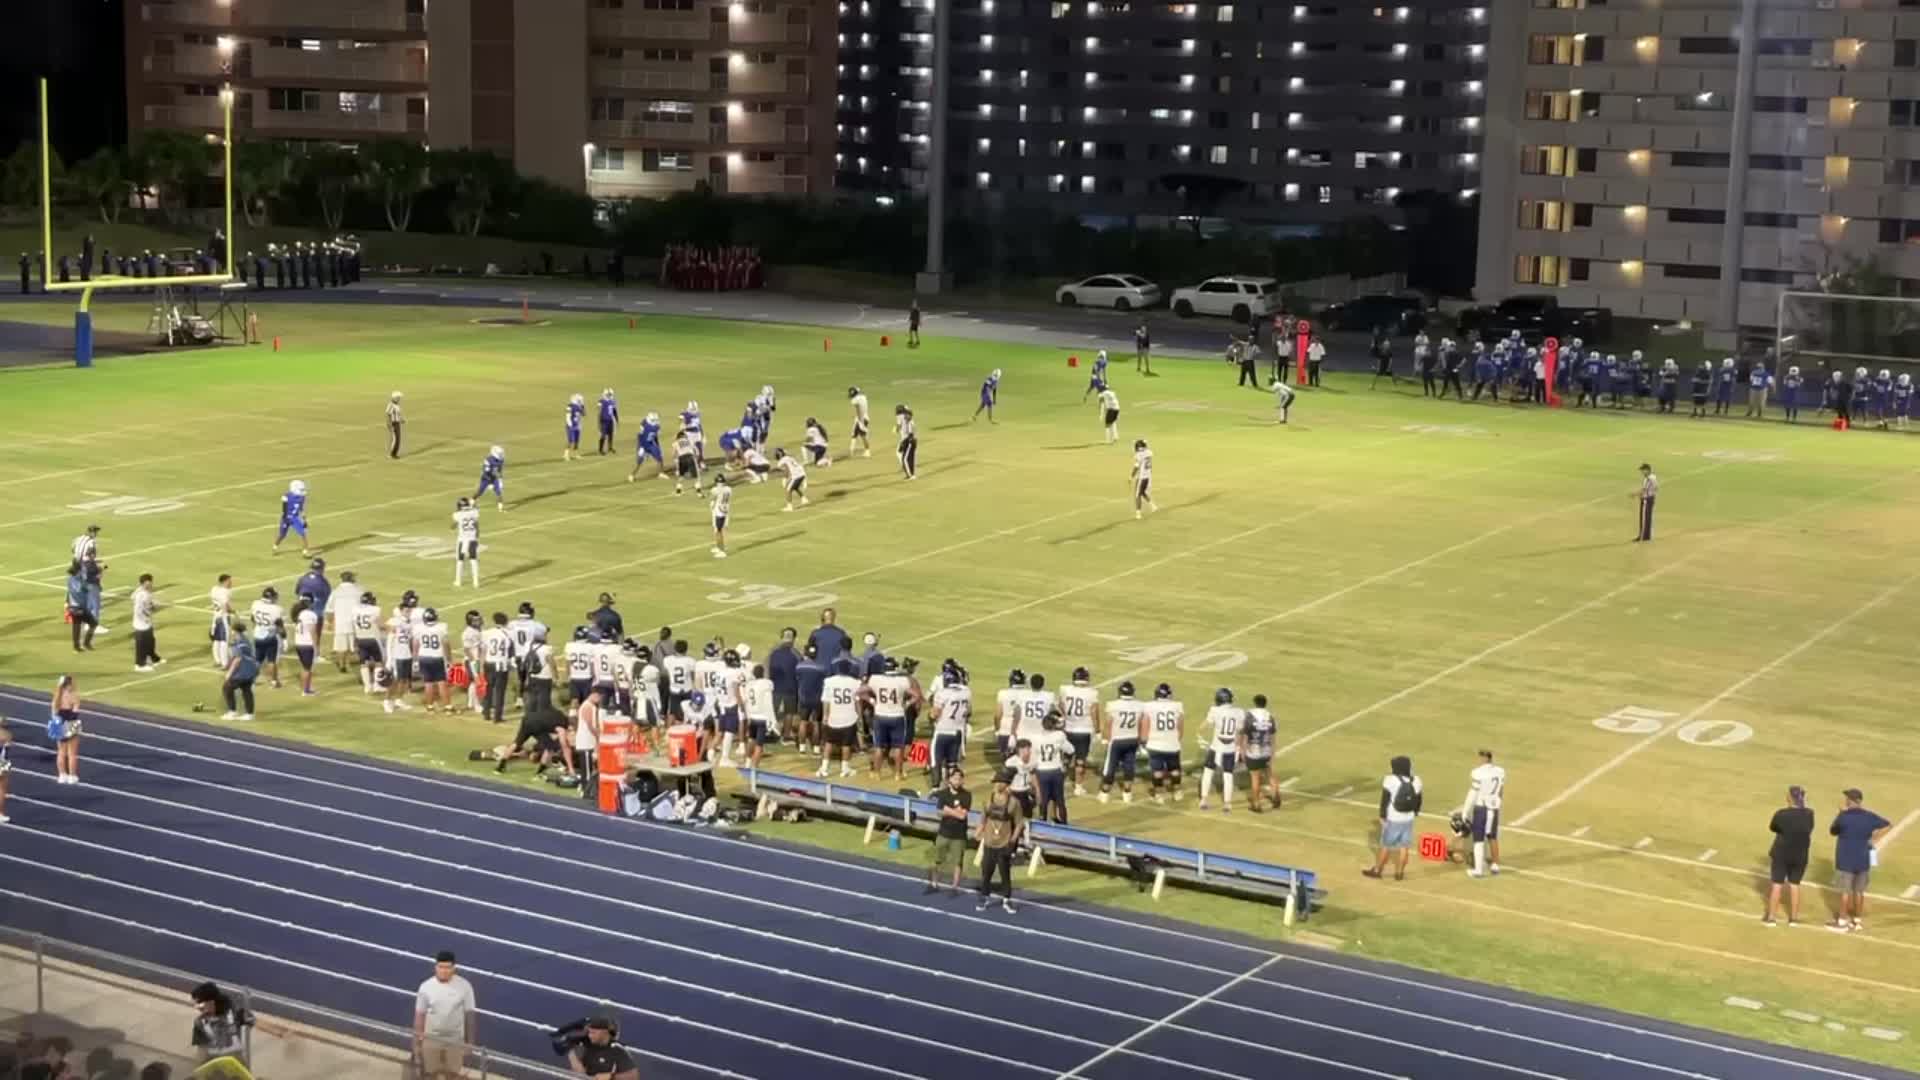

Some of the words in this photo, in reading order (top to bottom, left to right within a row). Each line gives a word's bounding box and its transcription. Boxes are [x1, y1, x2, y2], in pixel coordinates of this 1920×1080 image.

[705, 584, 839, 611] 30
[254, 610, 270, 626] 55
[421, 633, 440, 651] 98
[489, 638, 506, 656] 34
[517, 630, 526, 646] 0
[570, 652, 588, 671] 25
[600, 654, 608, 672] 6
[1108, 643, 1249, 672] 40
[673, 666, 685, 685] 2
[833, 687, 851, 705] 56
[878, 687, 898, 705] 64
[1024, 700, 1045, 719] 65
[1065, 696, 1084, 717] 78
[1119, 711, 1136, 729] 72
[1156, 711, 1176, 731] 66
[1220, 717, 1237, 736] 10
[1592, 705, 1754, 746] 50
[910, 743, 926, 763] 40
[1421, 837, 1442, 858] 50
